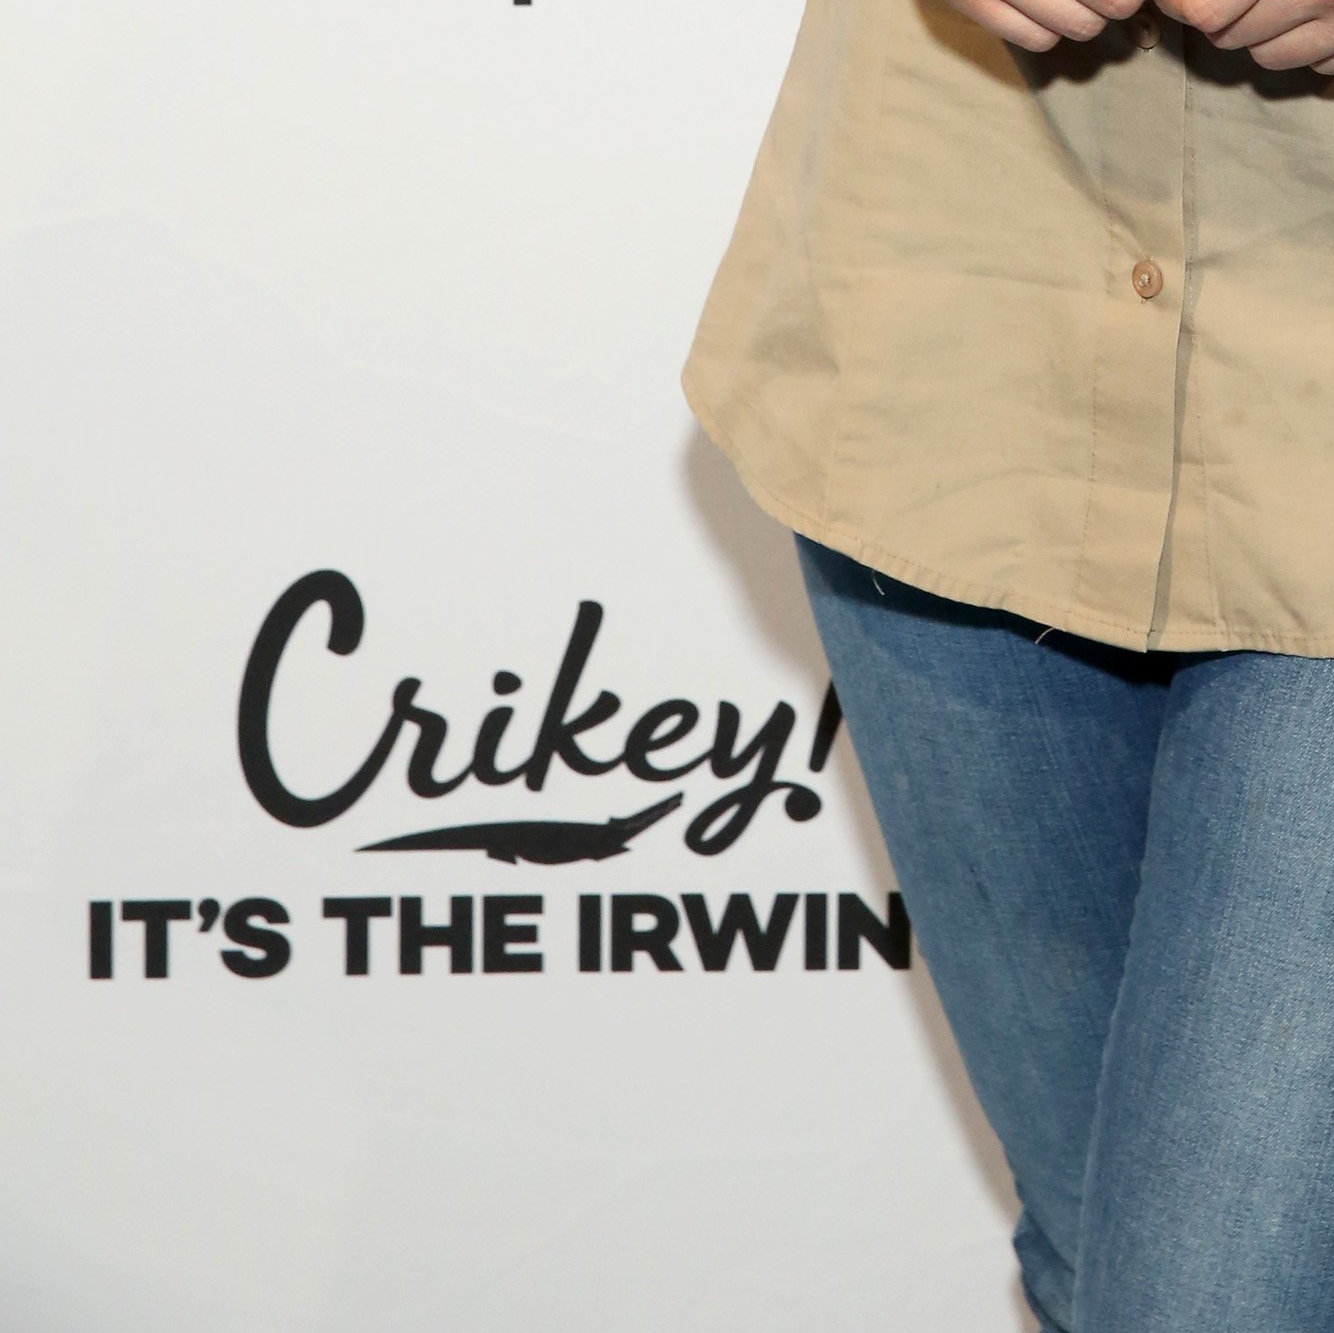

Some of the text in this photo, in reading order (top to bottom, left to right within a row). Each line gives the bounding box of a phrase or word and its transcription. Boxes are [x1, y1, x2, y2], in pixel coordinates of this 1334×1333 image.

[89, 891, 912, 980] IT'S THE IRWIN
